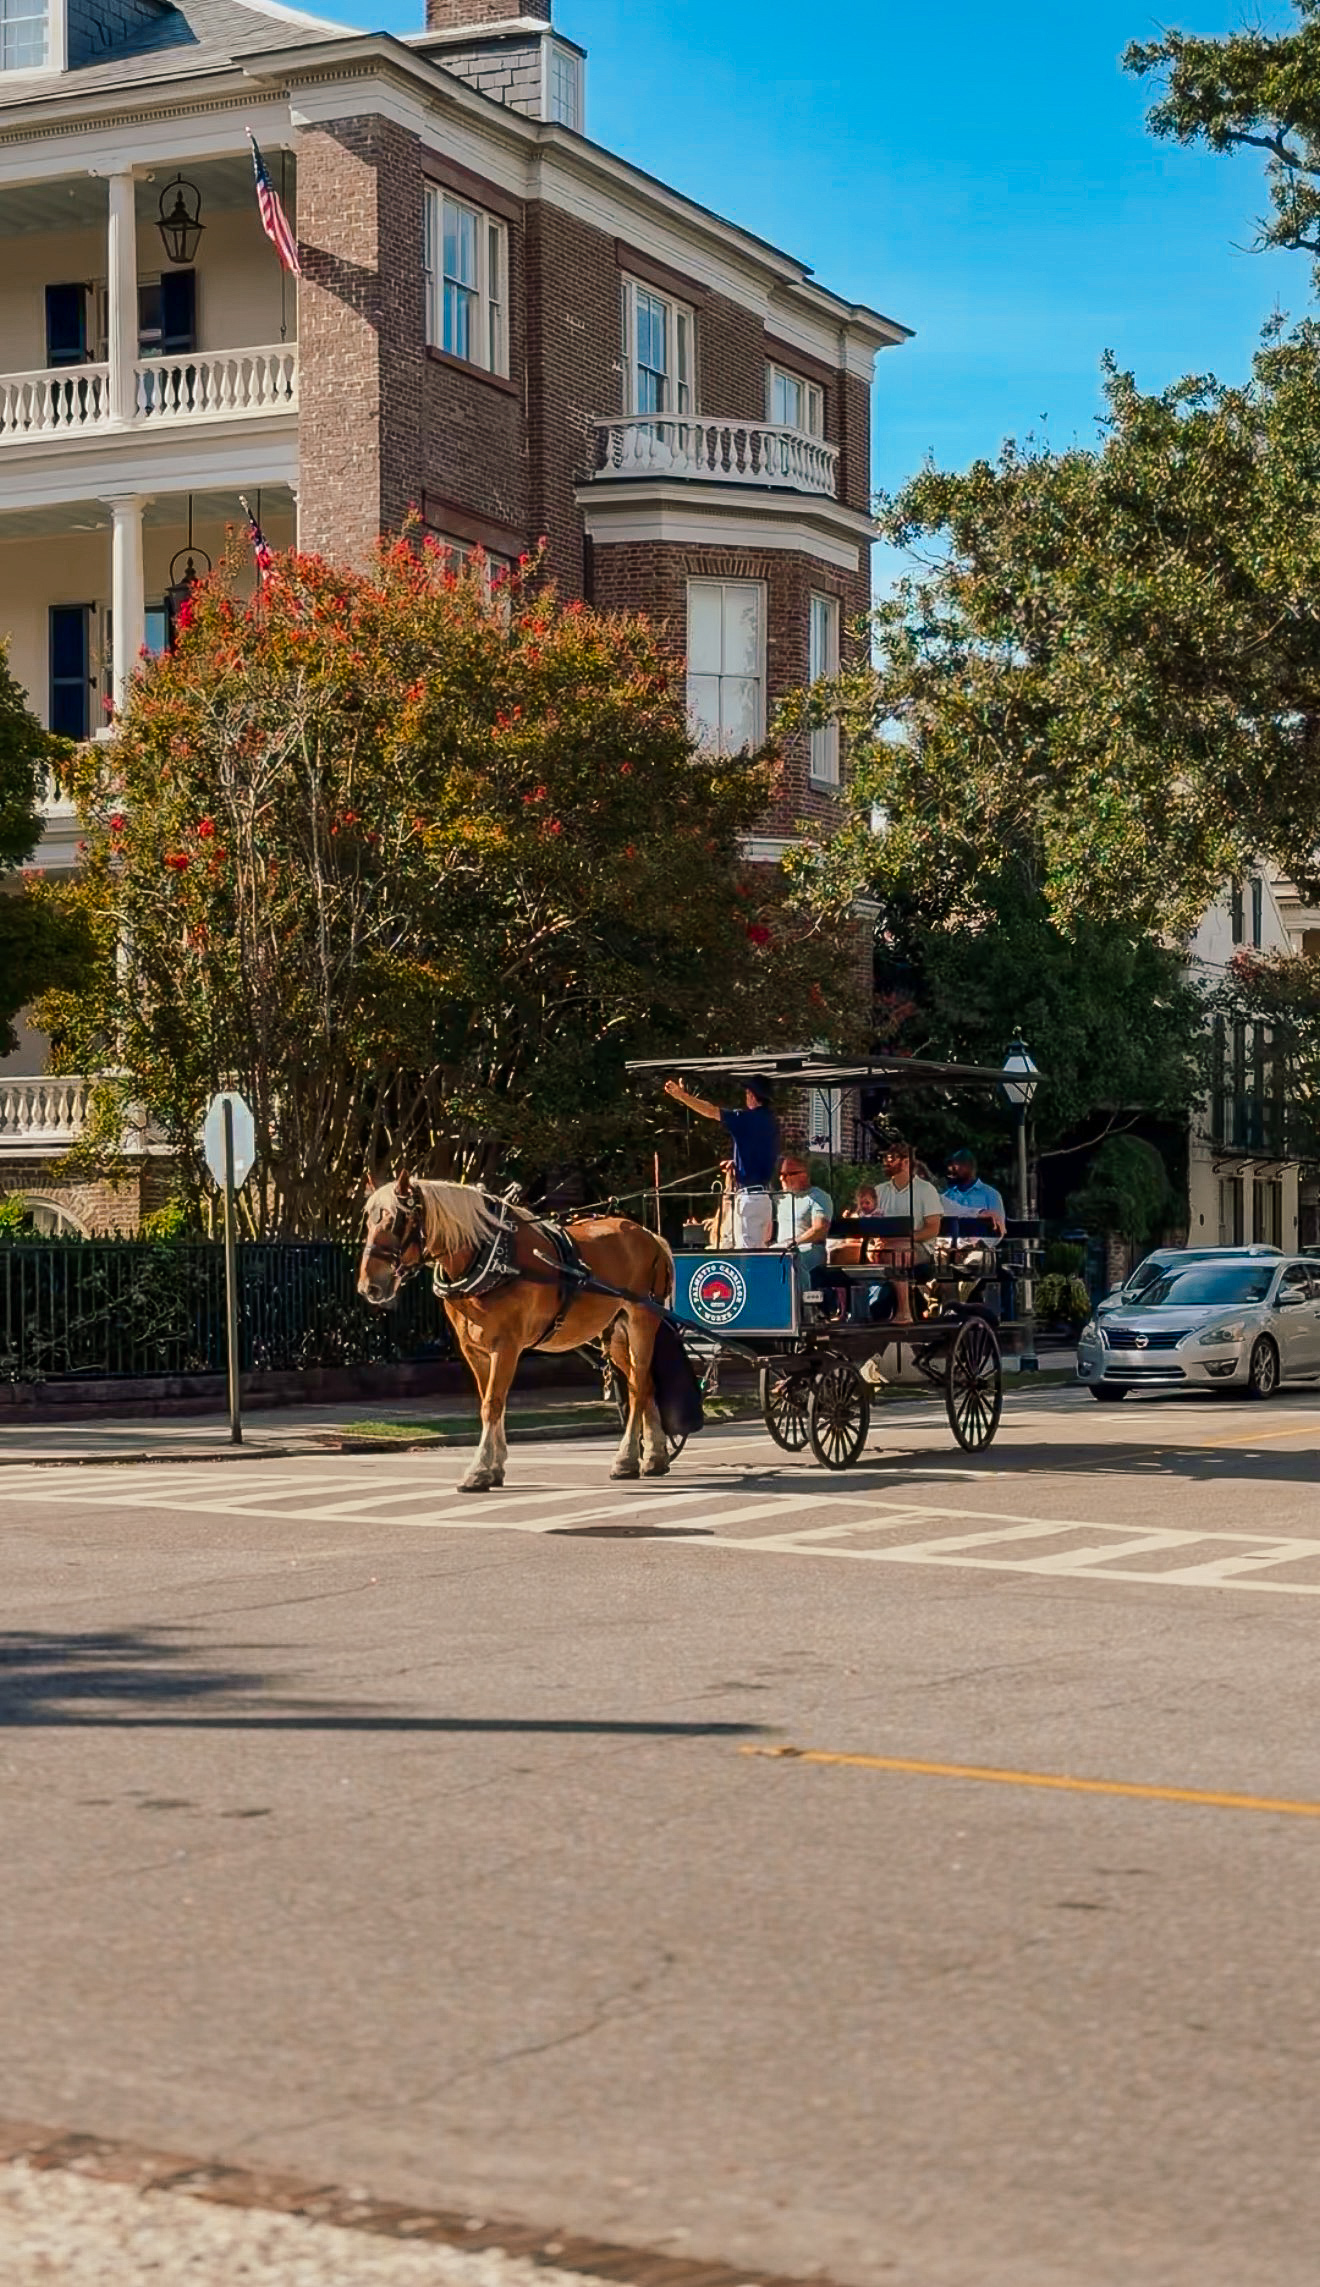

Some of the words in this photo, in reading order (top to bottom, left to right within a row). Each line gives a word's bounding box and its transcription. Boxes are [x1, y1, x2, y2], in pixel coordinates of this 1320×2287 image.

[692, 1264, 717, 1303] PALMETTO
[719, 1264, 743, 1303] CARRIAGE
[704, 1312, 732, 1322] WORKS
